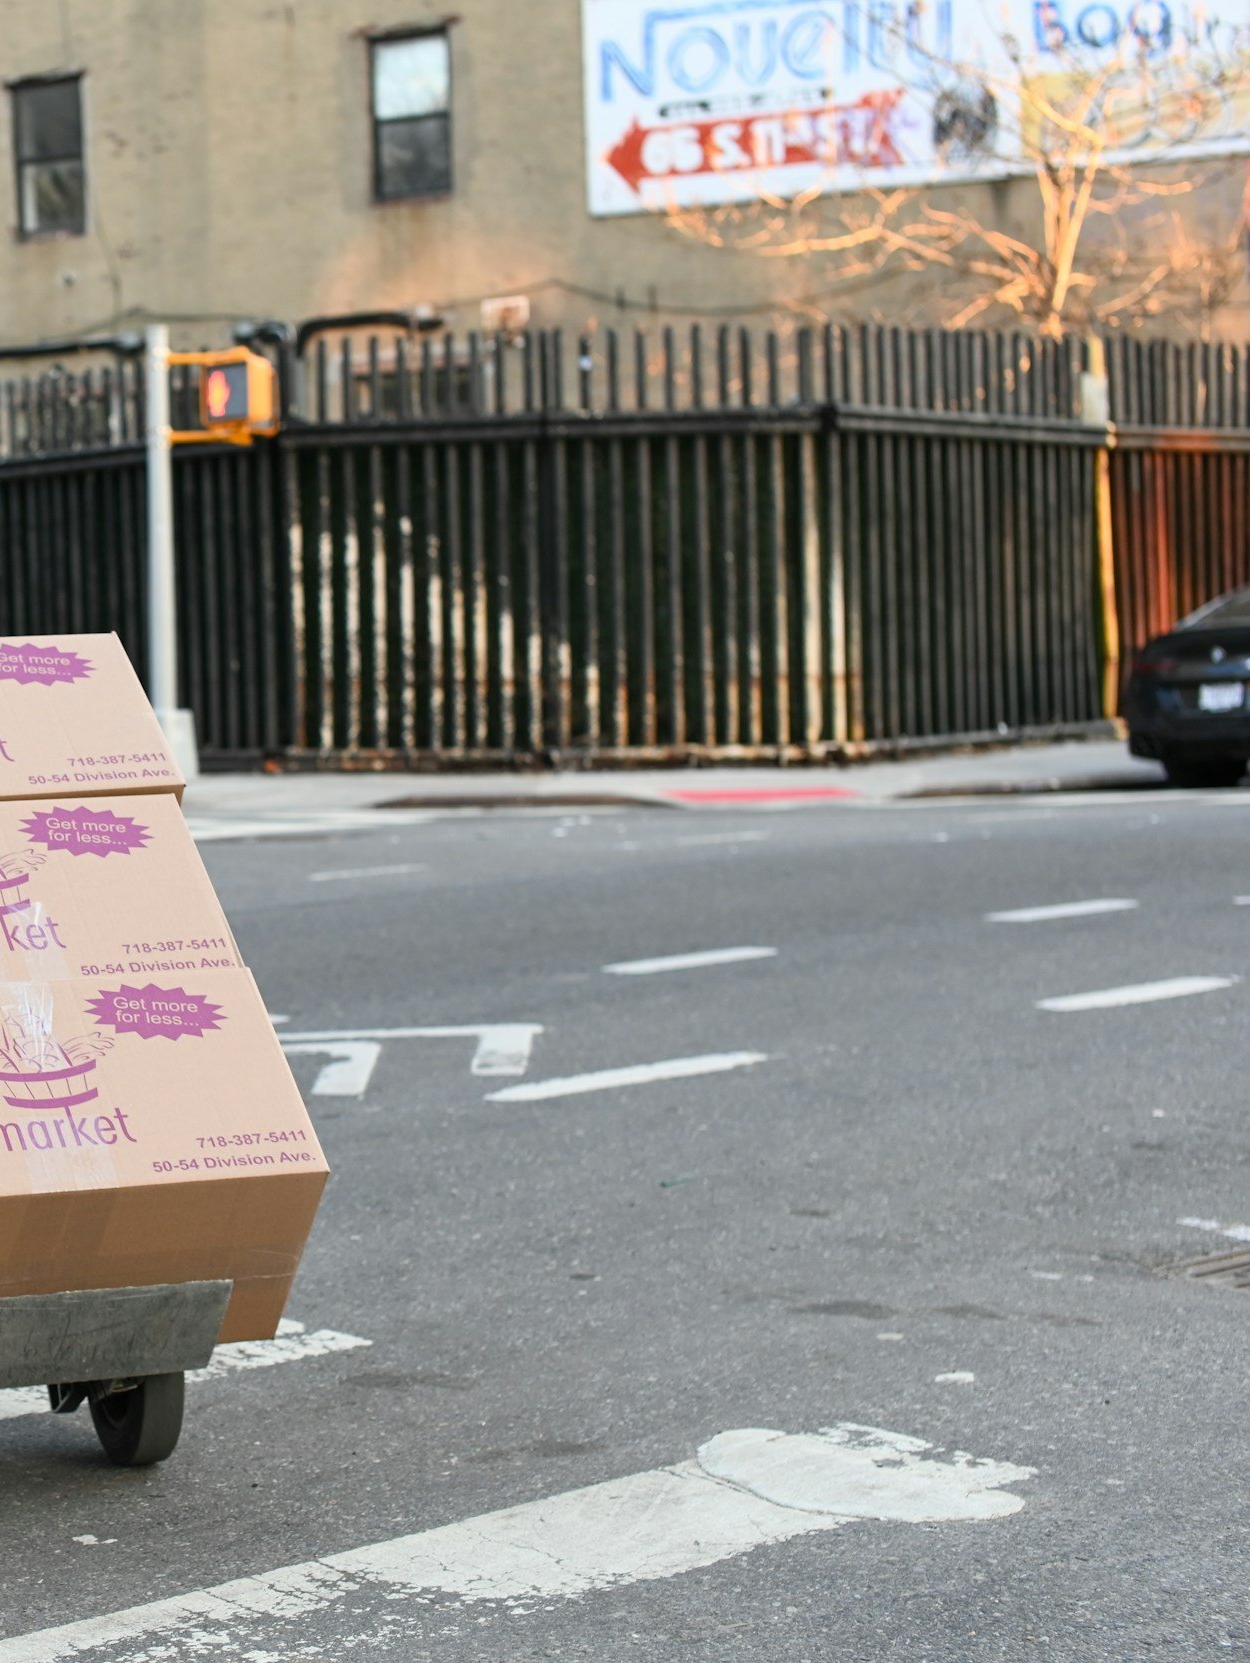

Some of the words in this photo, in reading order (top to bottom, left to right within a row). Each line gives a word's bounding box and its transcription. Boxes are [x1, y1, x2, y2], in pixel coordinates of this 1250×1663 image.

[29, 656, 71, 666] more
[67, 753, 166, 767] 718-387-5411
[28, 774, 70, 785] 50-54
[74, 770, 137, 782] Division
[142, 768, 175, 777] Ave.
[45, 817, 78, 830] Get
[82, 821, 126, 833] more
[48, 830, 71, 841] for
[122, 938, 227, 955] 718-387-5411
[81, 963, 125, 976] 50-54
[129, 959, 196, 973] Division
[201, 957, 236, 968] Ave.
[113, 996, 147, 1010] Get
[151, 1001, 198, 1013] more
[115, 1009, 140, 1023] for
[196, 1129, 307, 1149] 718-387-5411
[152, 1158, 200, 1173] 50-54
[203, 1154, 275, 1169] Division
[280, 1151, 316, 1163] Ave.
